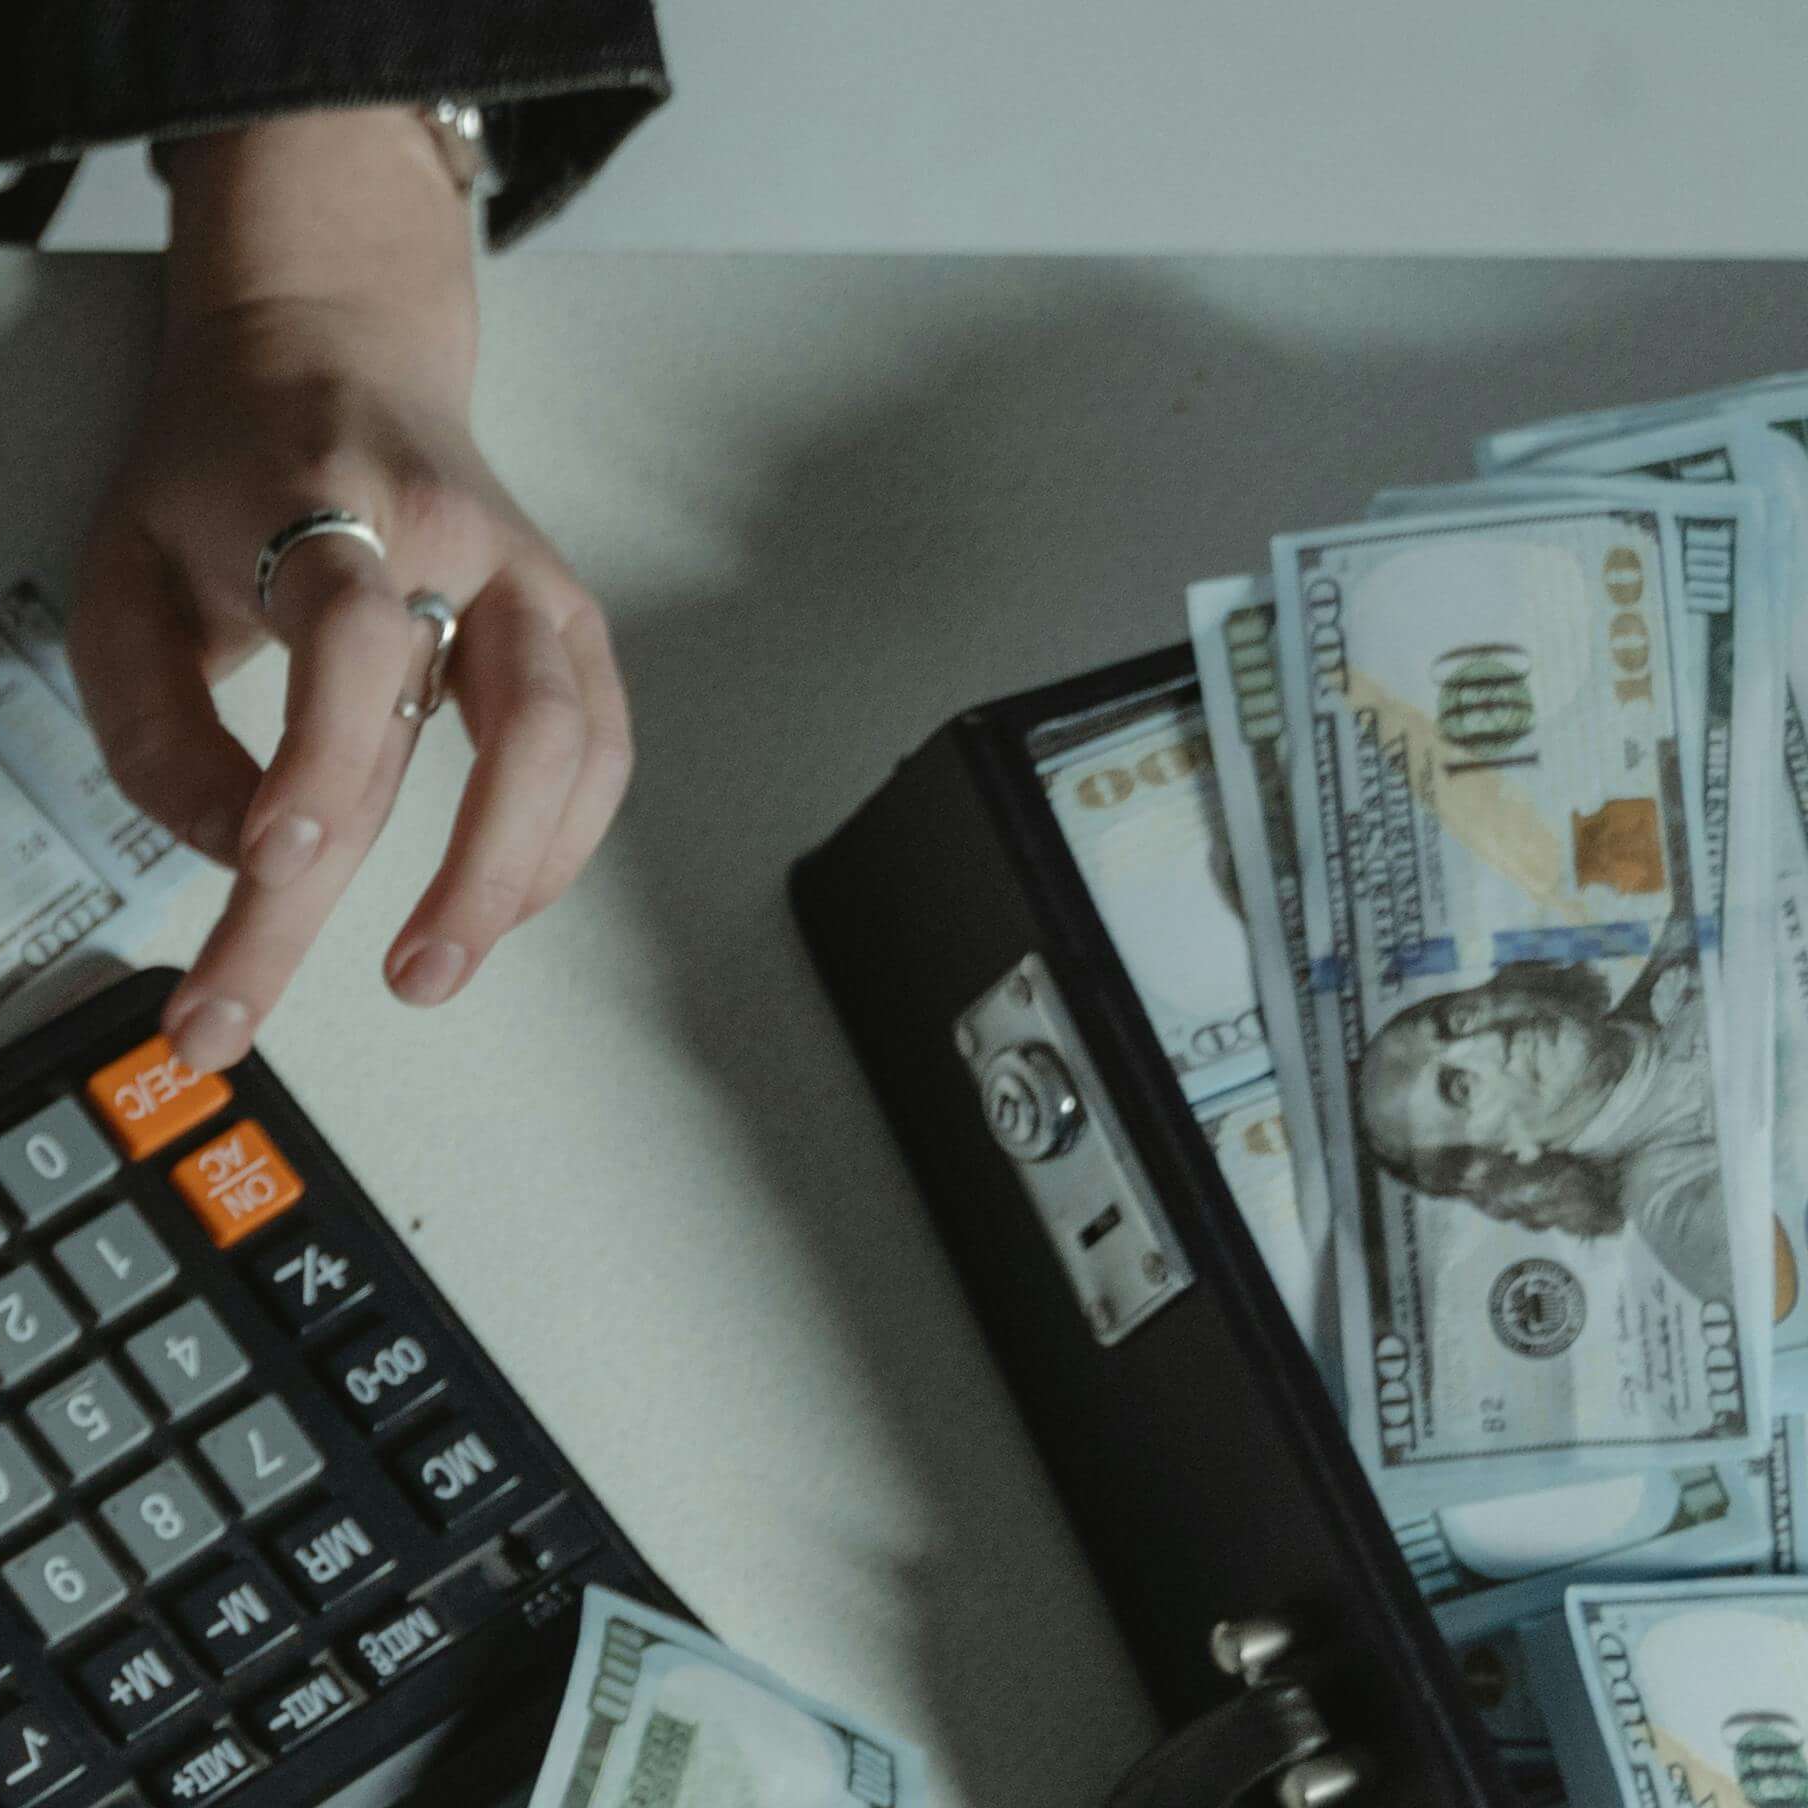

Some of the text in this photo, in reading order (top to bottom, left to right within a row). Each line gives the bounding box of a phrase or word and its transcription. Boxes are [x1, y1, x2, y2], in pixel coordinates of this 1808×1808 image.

[1602, 544, 1654, 704] 100
[27, 1135, 67, 1178] 0
[96, 1239, 130, 1278] 1
[166, 1337, 199, 1378] 4
[1374, 1334, 1416, 1451] 100
[68, 1394, 109, 1441] 5
[248, 1430, 284, 1478] 7
[423, 1435, 495, 1499] MC
[141, 1494, 183, 1539] 8
[295, 1519, 371, 1583] MR
